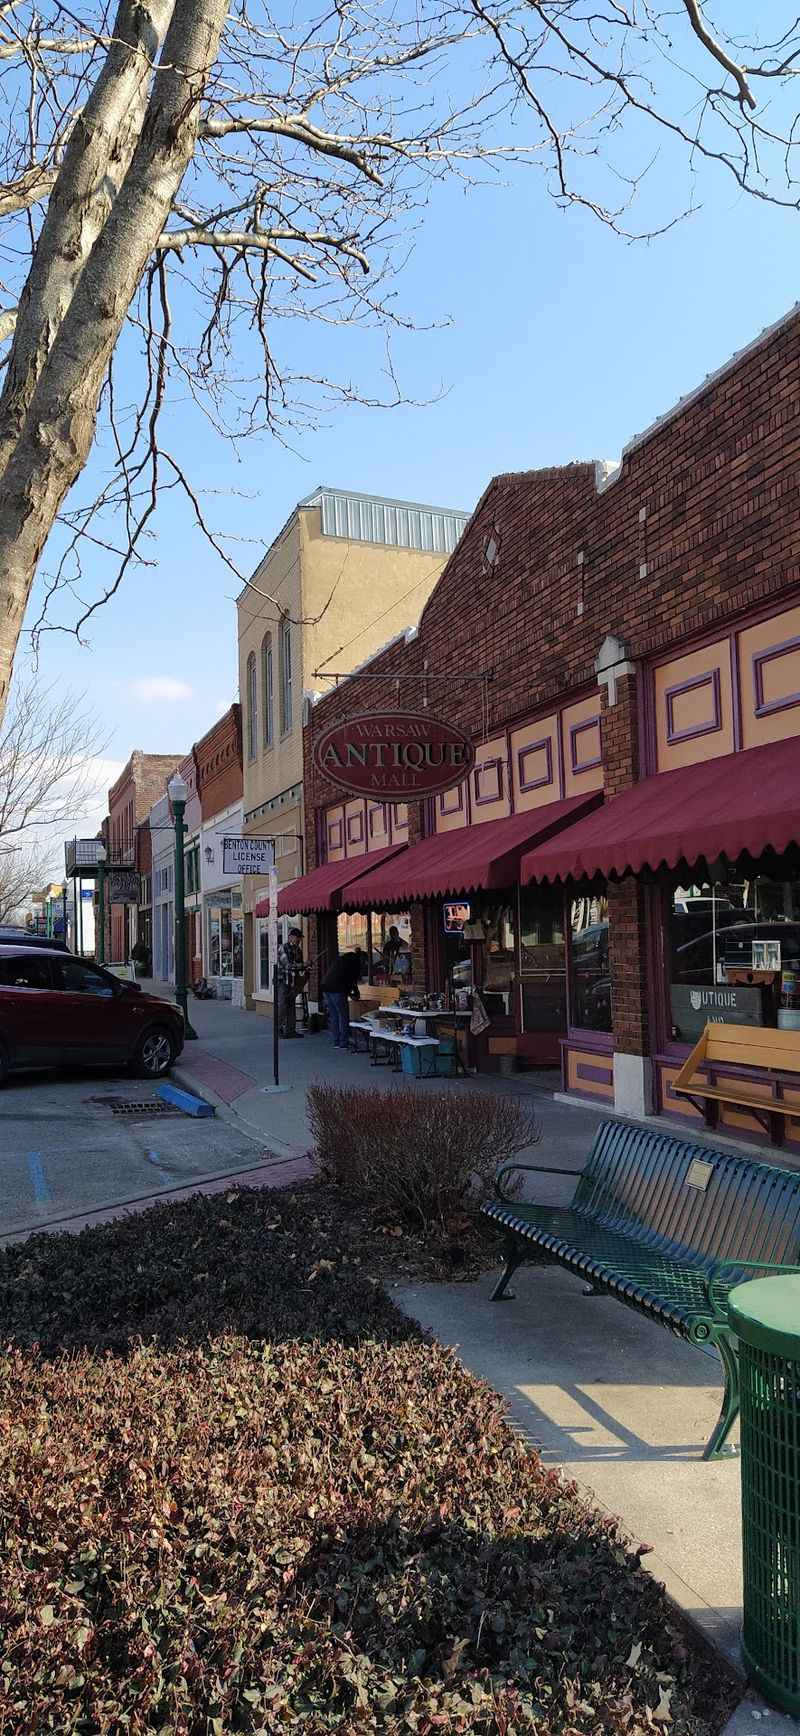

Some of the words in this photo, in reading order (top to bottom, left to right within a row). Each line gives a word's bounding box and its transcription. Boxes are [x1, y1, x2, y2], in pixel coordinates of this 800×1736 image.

[355, 724, 430, 737] WARSAW
[323, 743, 466, 771] ANTIQUE
[370, 774, 418, 786] MALL
[224, 840, 249, 850] BENTON
[250, 840, 274, 850] COUNTY
[232, 852, 265, 862] LICENSE
[237, 864, 261, 873] OFFICE
